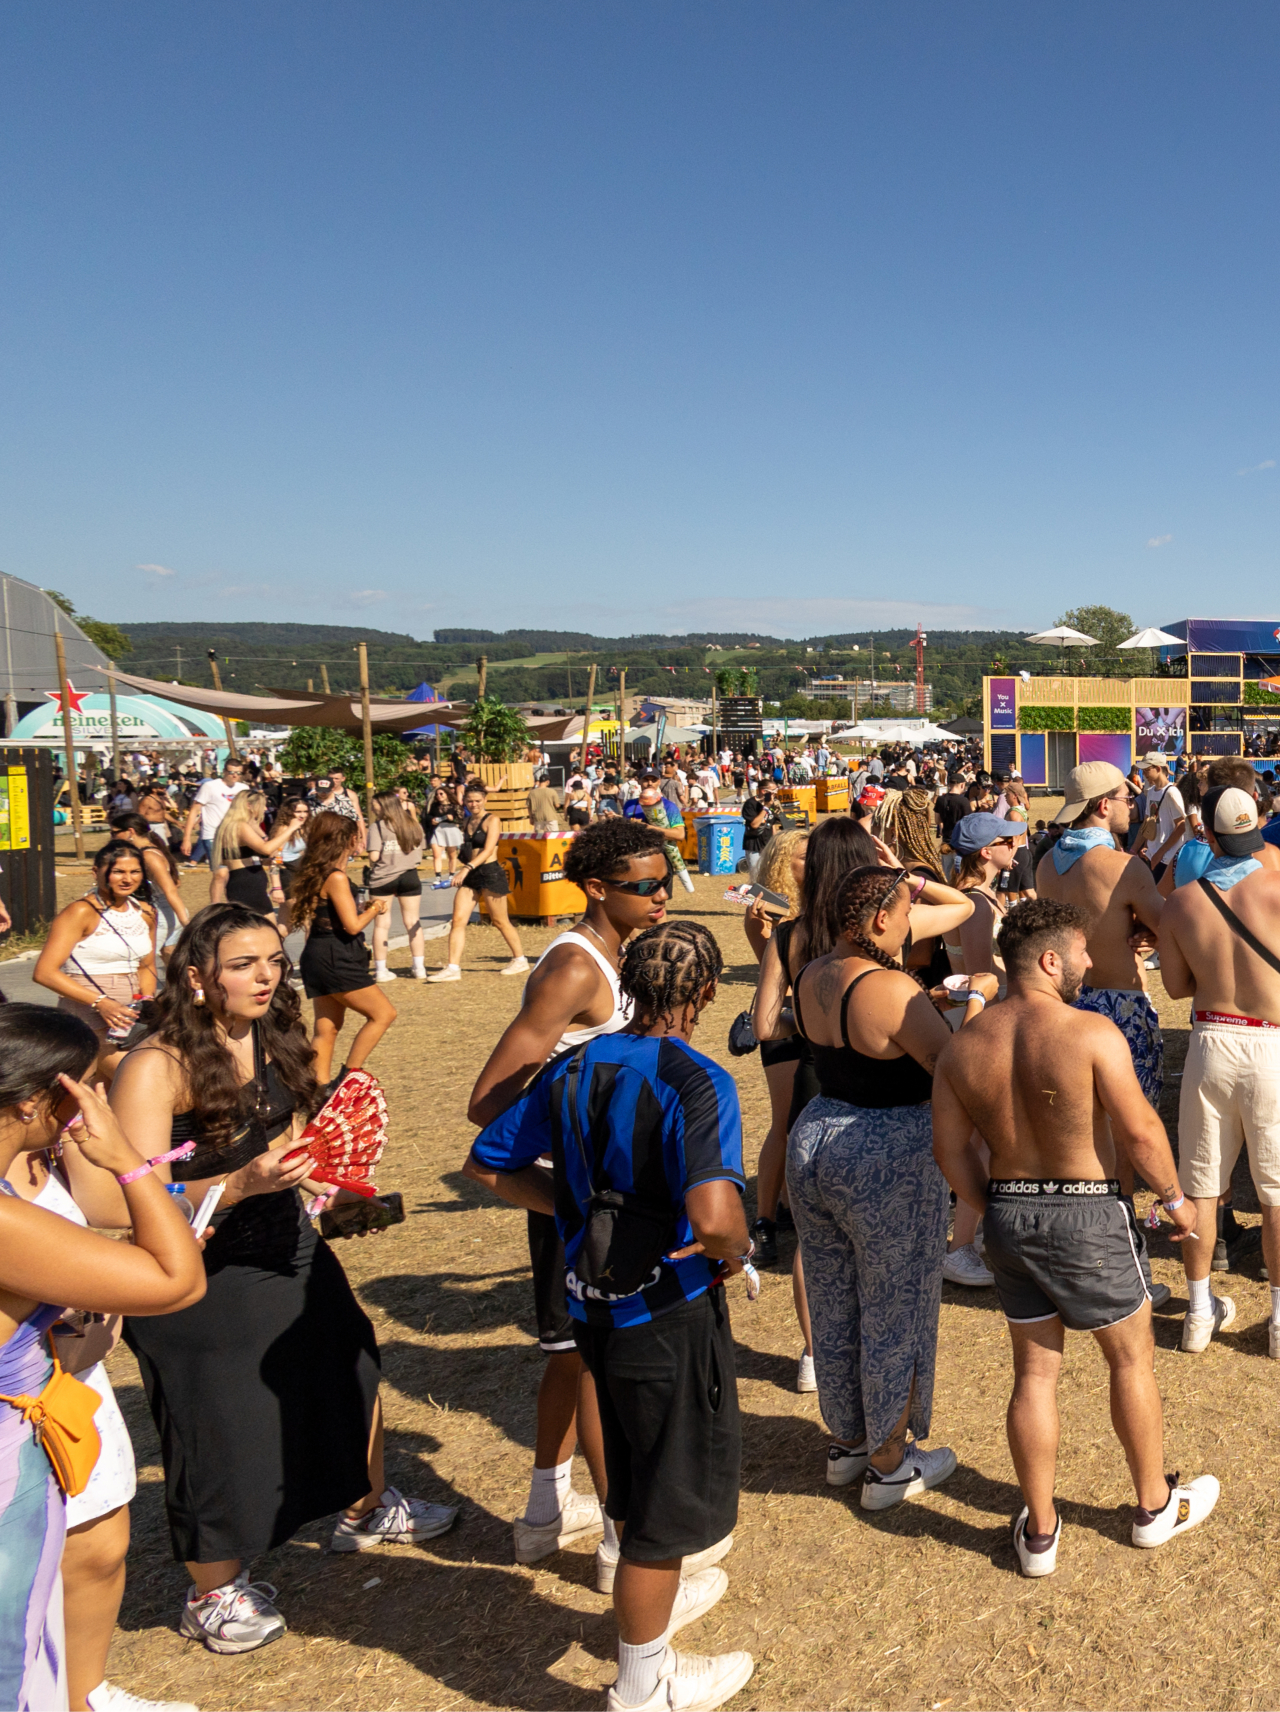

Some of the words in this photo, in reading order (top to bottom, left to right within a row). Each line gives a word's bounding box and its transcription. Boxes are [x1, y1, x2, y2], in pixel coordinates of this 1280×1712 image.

[1138, 726, 1154, 736] Du
[1168, 726, 1184, 737] Ich
[1205, 1011, 1248, 1027] Supreme
[999, 1181, 1039, 1194] adidas
[1062, 1180, 1109, 1194] adidas
